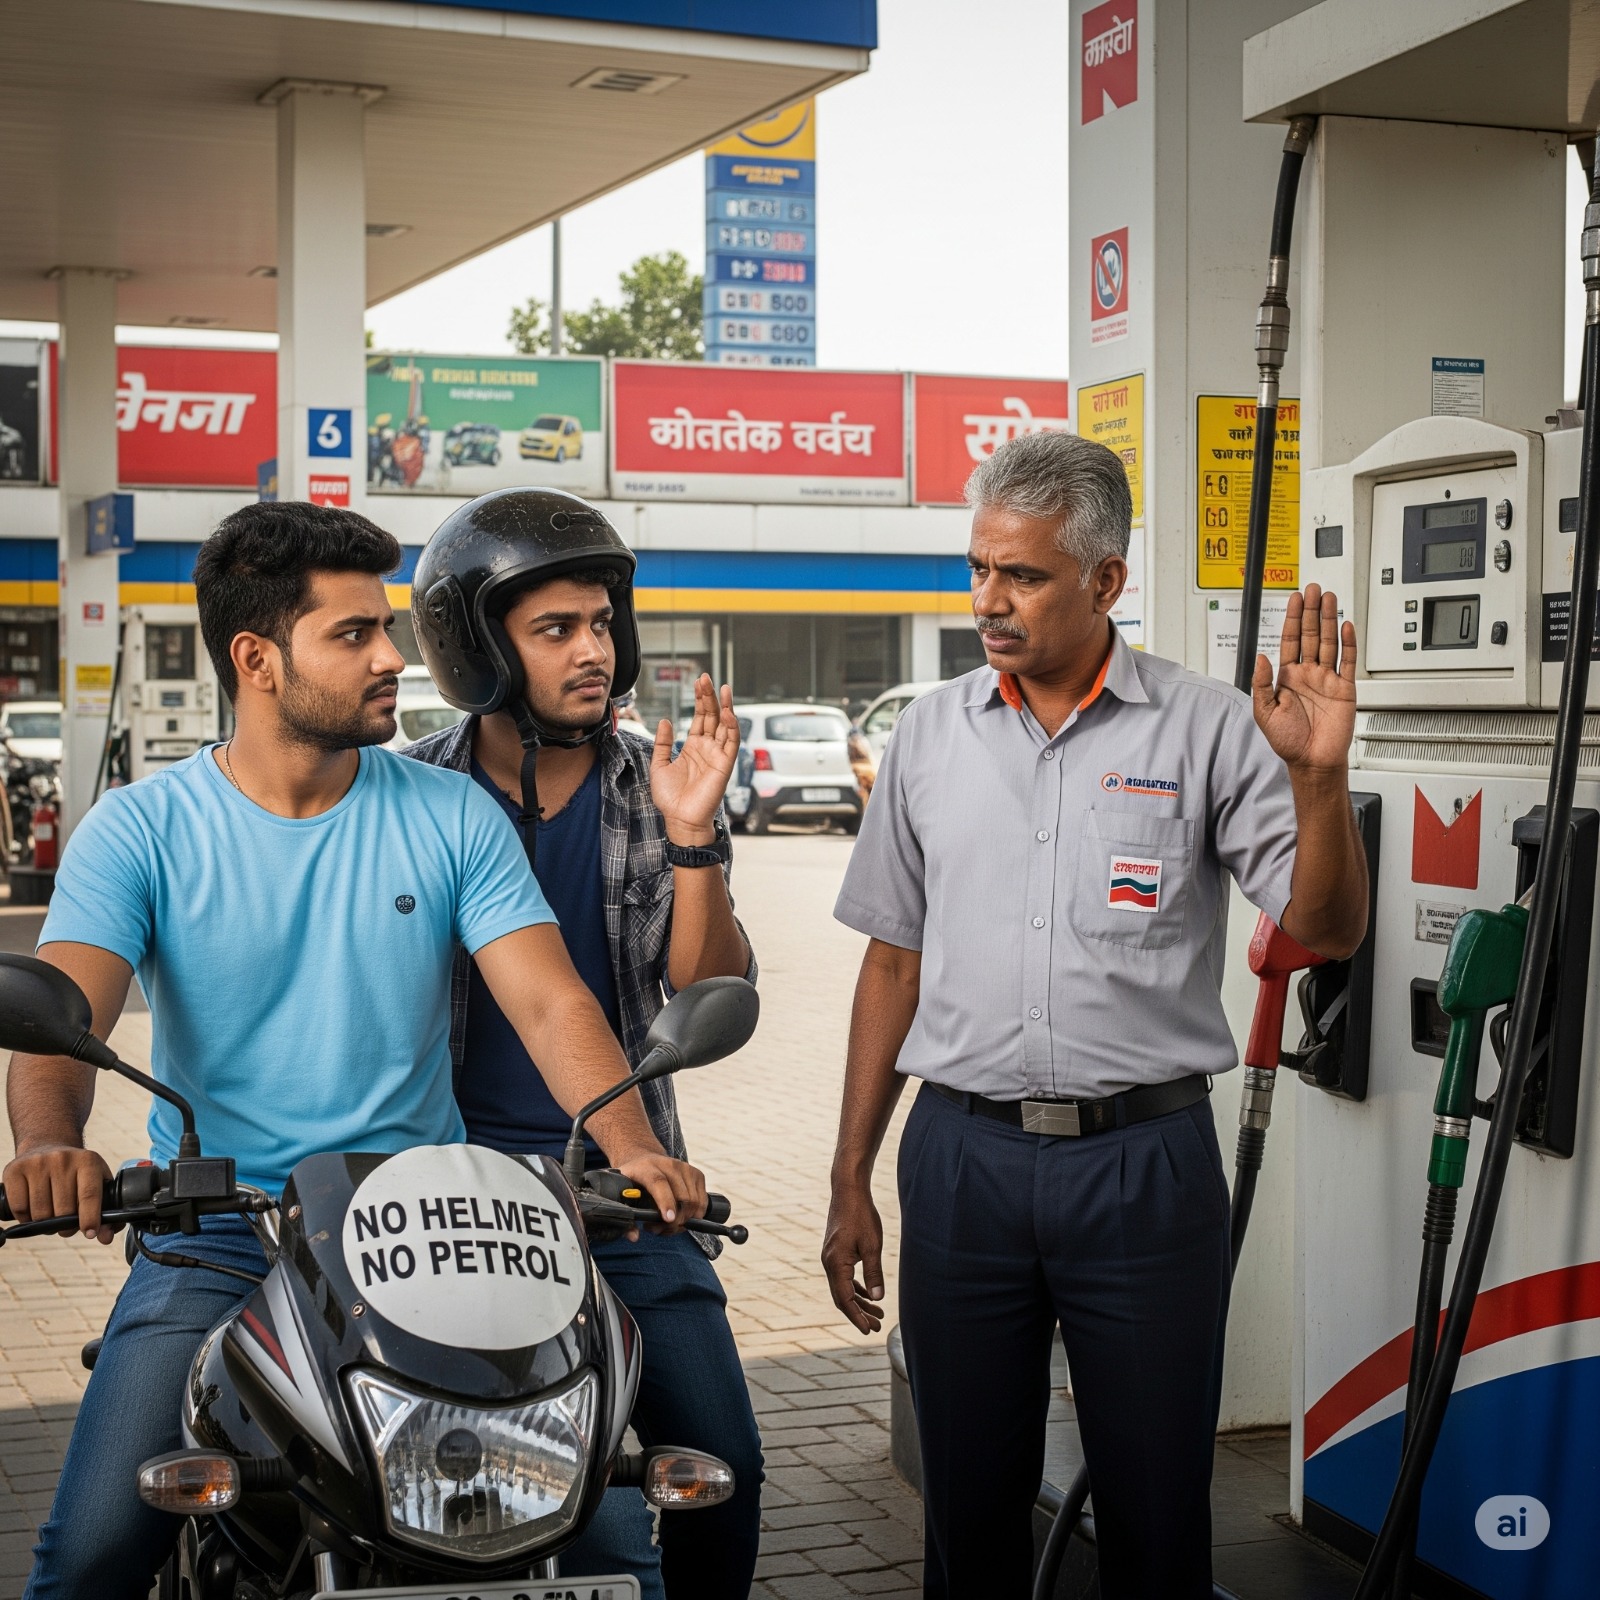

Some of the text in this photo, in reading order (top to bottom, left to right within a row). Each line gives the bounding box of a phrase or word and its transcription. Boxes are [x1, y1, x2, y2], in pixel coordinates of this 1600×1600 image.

[317, 413, 342, 449] 6
[353, 1197, 560, 1242] NO HELMET
[361, 1240, 571, 1287] NO PETROL
